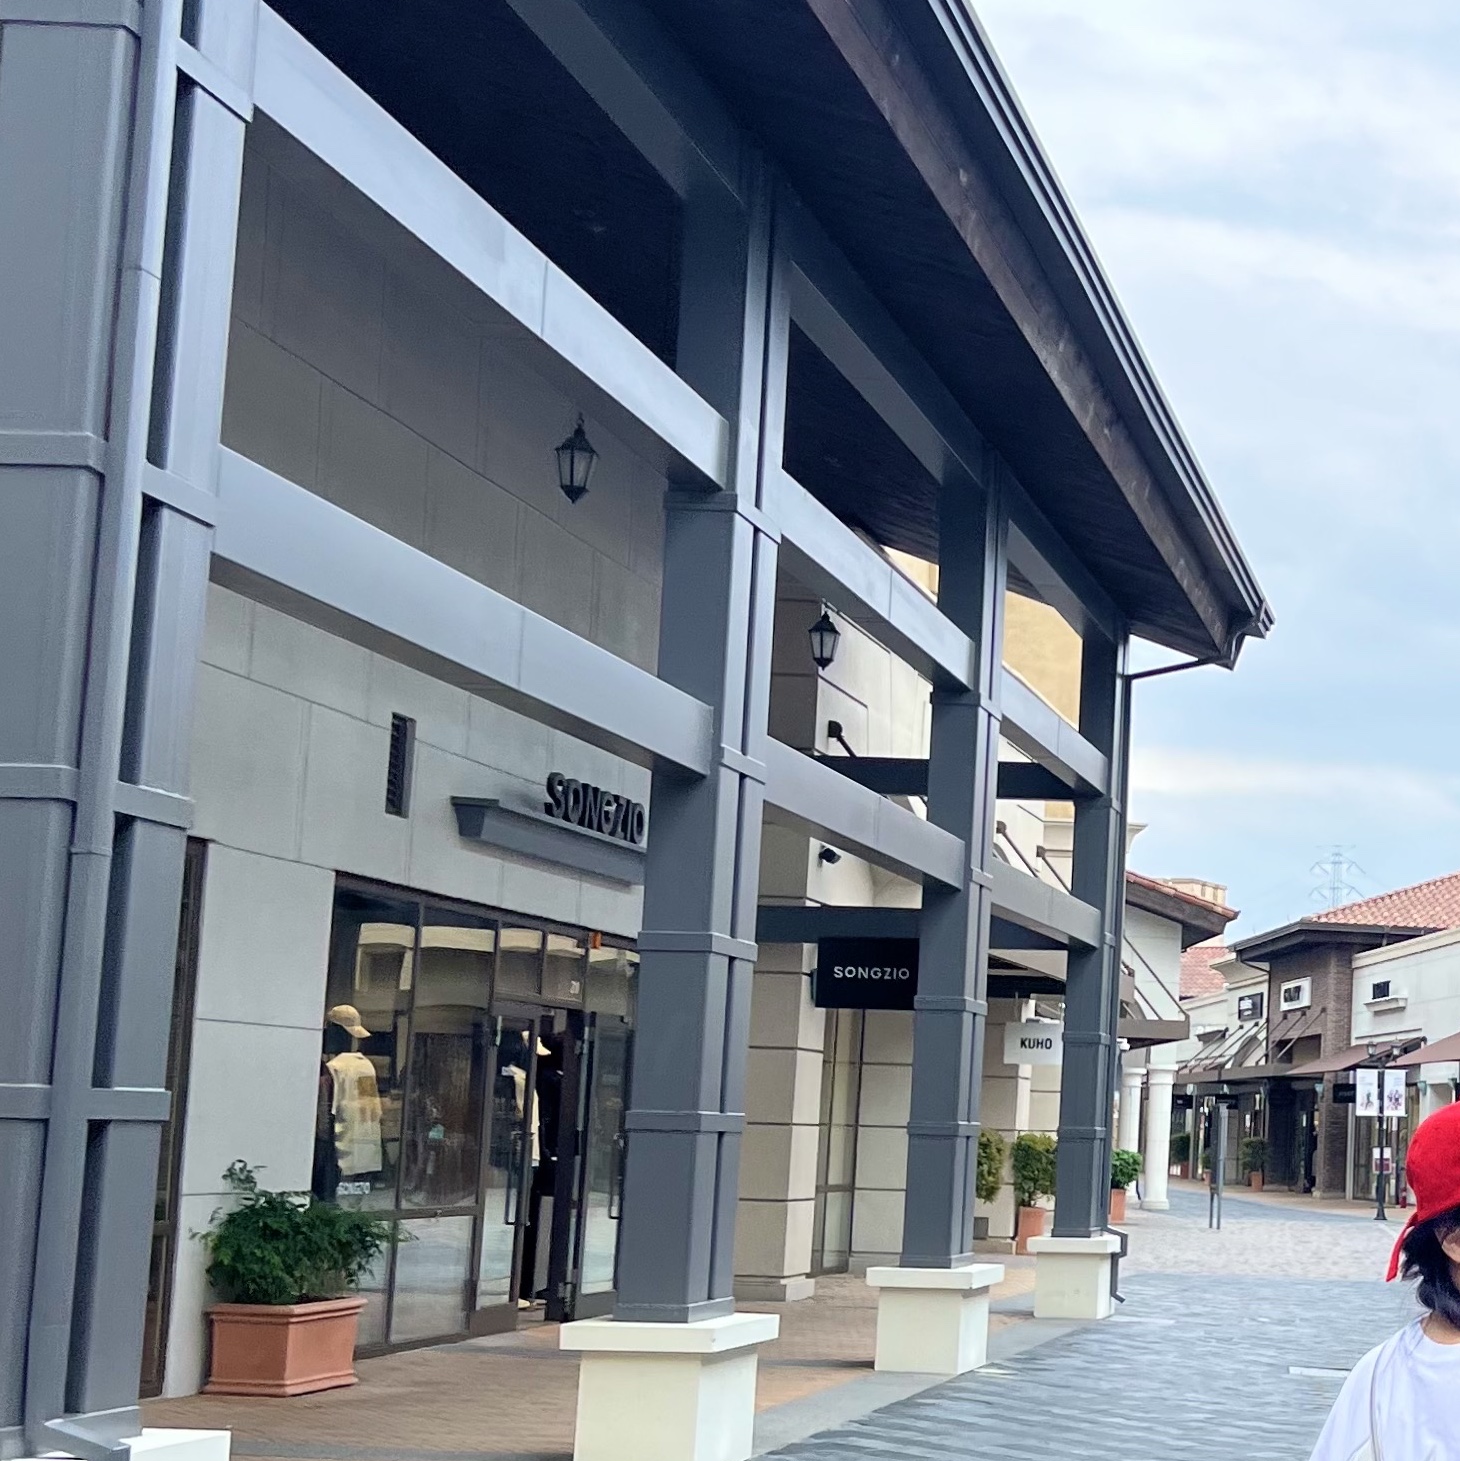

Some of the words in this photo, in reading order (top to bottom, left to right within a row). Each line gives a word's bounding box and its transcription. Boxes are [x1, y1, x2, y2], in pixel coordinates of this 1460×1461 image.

[543, 770, 646, 846] SONGZIO
[833, 965, 910, 980] SONGZIO
[1020, 1037, 1053, 1050] KUHO
